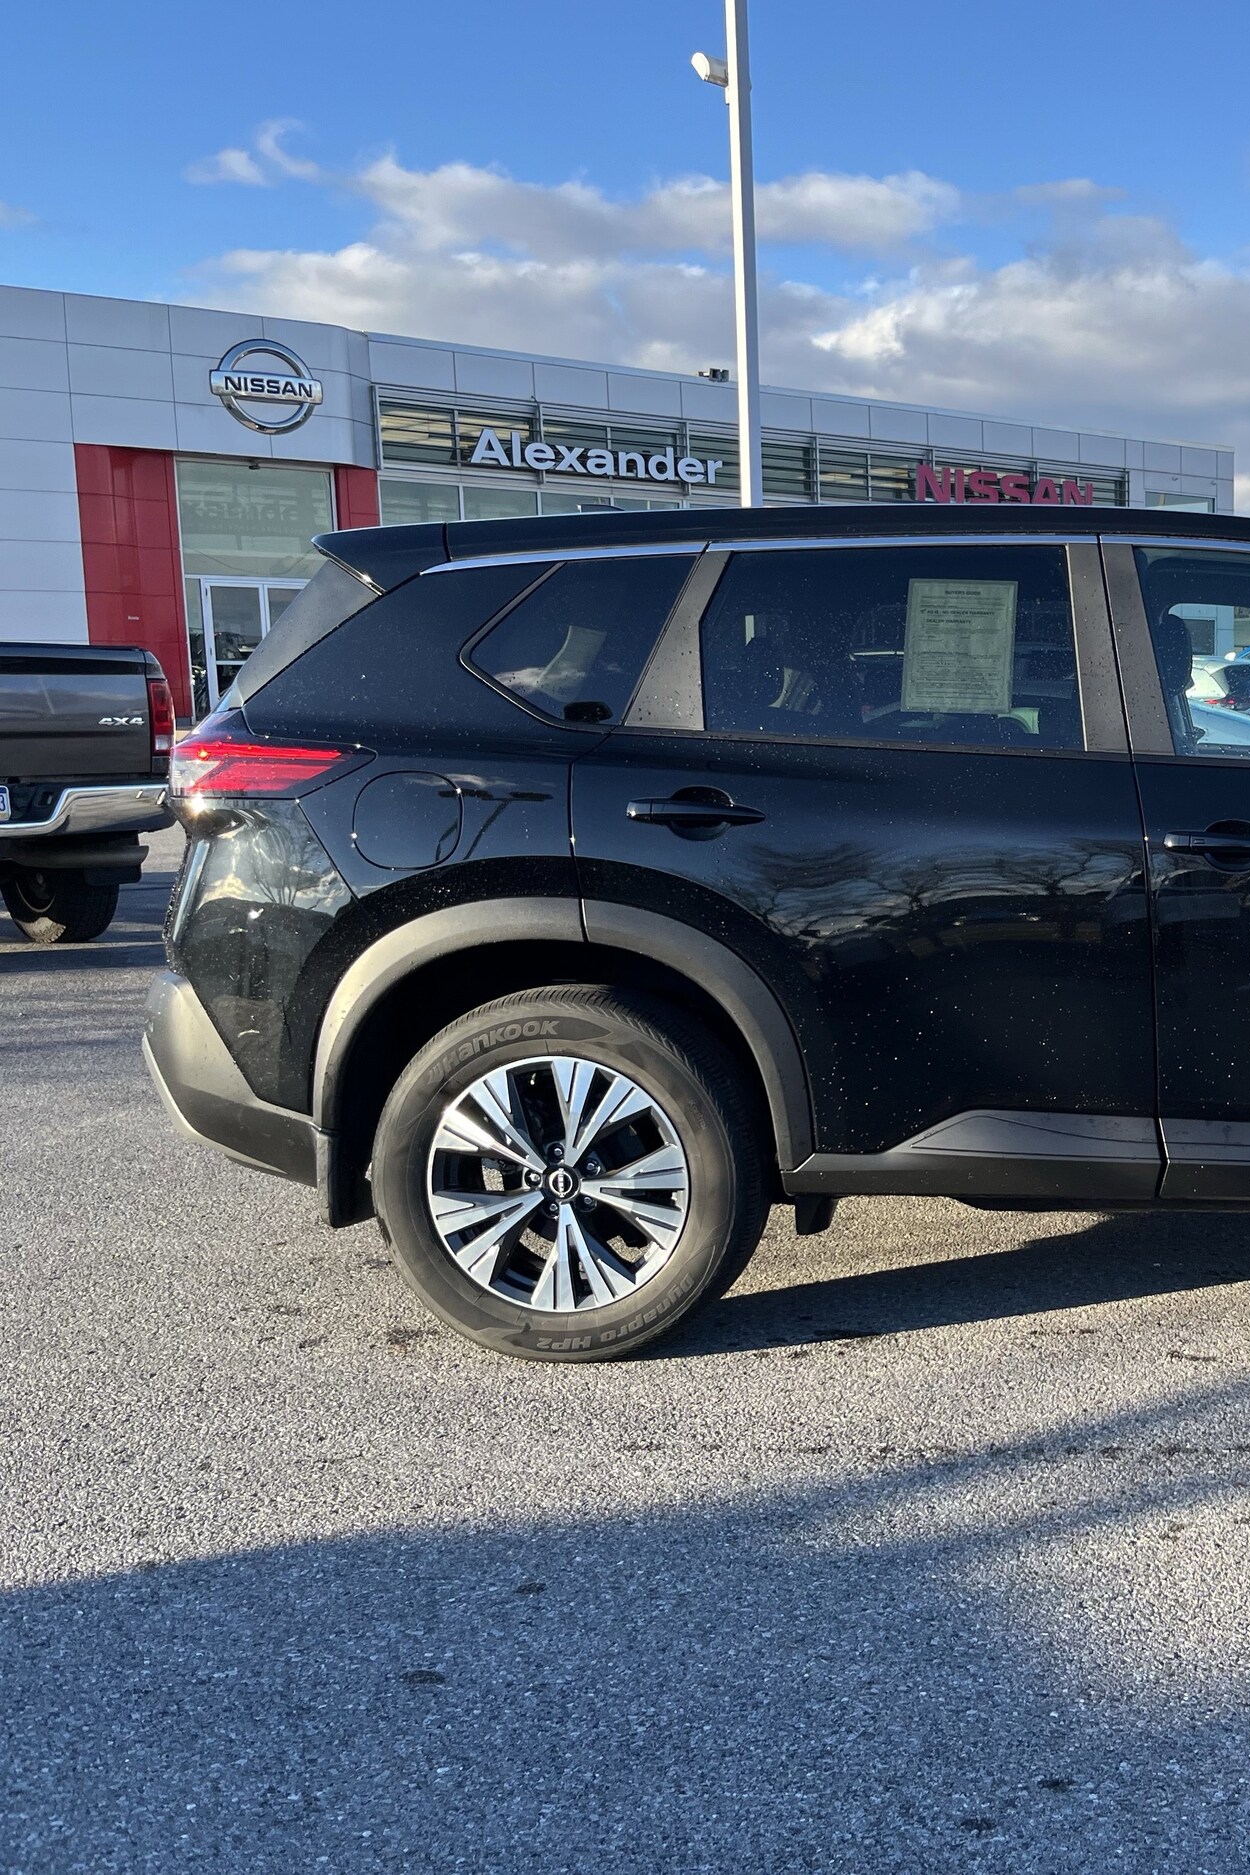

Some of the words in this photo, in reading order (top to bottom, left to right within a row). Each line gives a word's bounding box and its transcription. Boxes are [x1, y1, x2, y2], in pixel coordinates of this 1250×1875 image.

[224, 375, 313, 398] NISSAN
[470, 427, 723, 485] Alexander
[915, 463, 1093, 506] NISSAN
[600, 1272, 696, 1343] Dynapro
[536, 1335, 592, 1350] HP2
